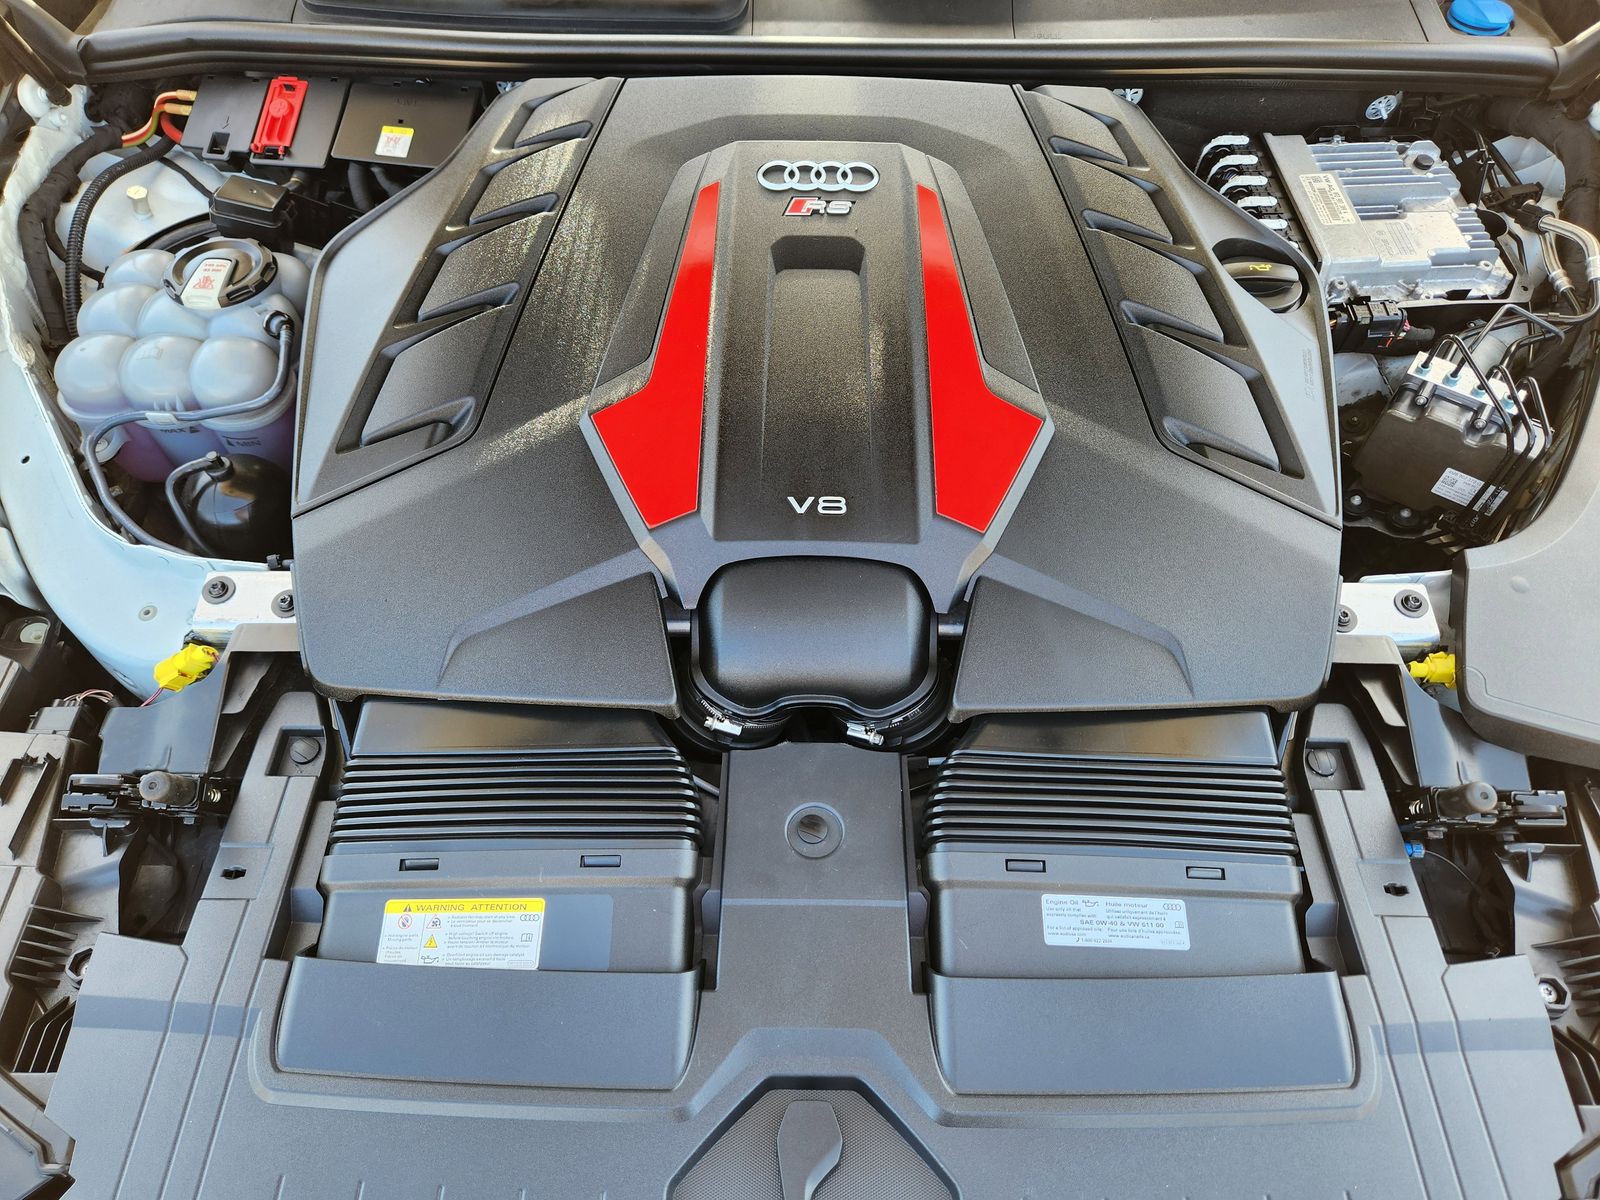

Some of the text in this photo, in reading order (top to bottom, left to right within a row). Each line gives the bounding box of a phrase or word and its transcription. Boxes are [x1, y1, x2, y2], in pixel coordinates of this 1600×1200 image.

[786, 197, 852, 215] RS
[786, 496, 847, 515] V8
[416, 903, 465, 912] WARNING
[470, 903, 528, 911] ATTENTION
